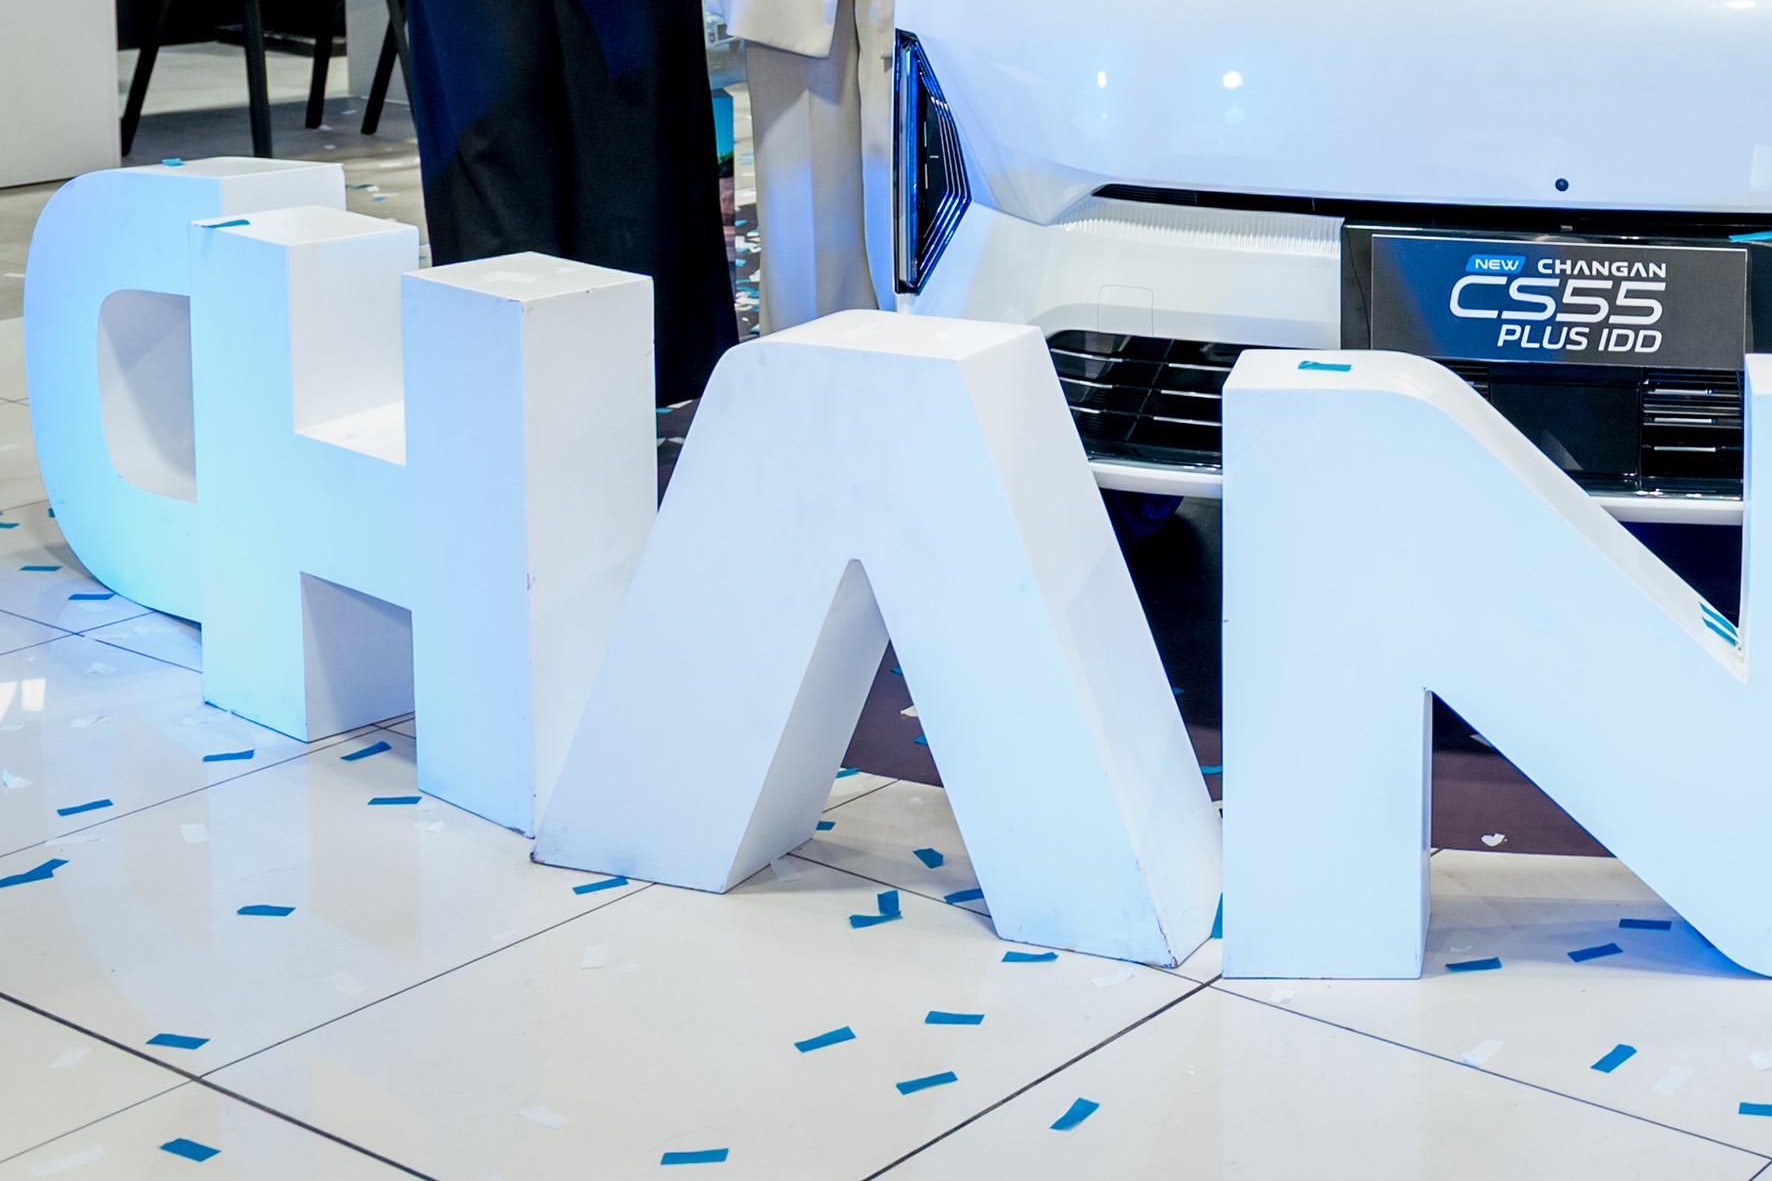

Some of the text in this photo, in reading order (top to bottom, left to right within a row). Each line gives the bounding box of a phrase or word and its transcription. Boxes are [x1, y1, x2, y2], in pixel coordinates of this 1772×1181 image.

[1474, 258, 1667, 279] NEW CHANGAN
[1449, 275, 1667, 325] CS55
[1497, 324, 1663, 353] PLUS IDD
